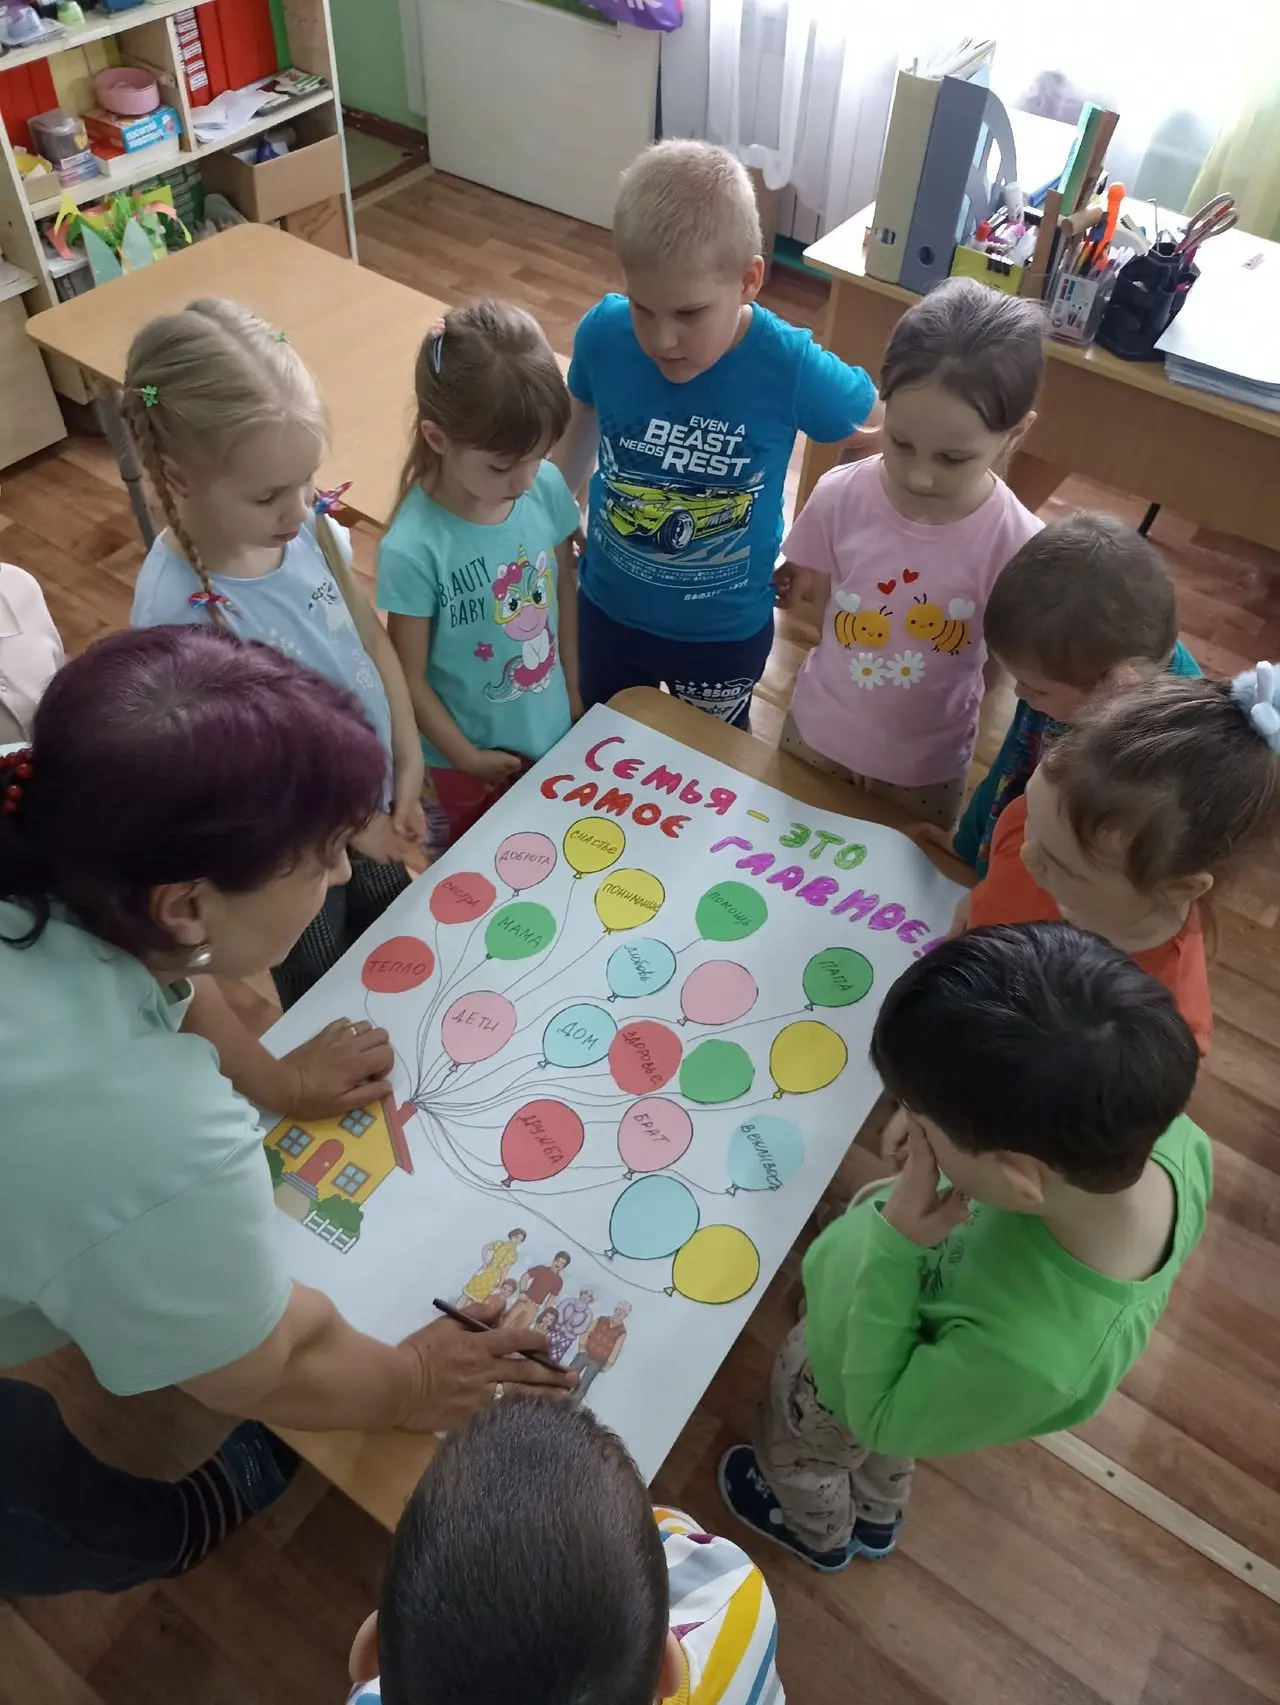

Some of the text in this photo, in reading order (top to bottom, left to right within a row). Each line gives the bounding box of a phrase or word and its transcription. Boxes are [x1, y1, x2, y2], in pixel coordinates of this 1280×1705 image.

[643, 418, 743, 455] BEAST
[690, 415, 746, 436] EVEN A
[619, 437, 751, 477] NEEDS REST
[450, 597, 486, 628] BABY
[540, 774, 692, 838] САМОЕ
[499, 850, 551, 866] ДОБРОТА
[569, 830, 618, 855] СЧАСТЬЕ
[779, 823, 868, 870] ЭТО
[707, 891, 752, 928] ПОМОЩЬ
[498, 916, 543, 948] МАМА
[368, 959, 427, 976] ТЕПЛО
[818, 961, 854, 993] ПАПА
[451, 1008, 499, 1033] ДЕТИ
[556, 1021, 599, 1051] ДОМ
[516, 1114, 565, 1165] ДРУЖБА
[633, 1112, 671, 1145] БРАТ
